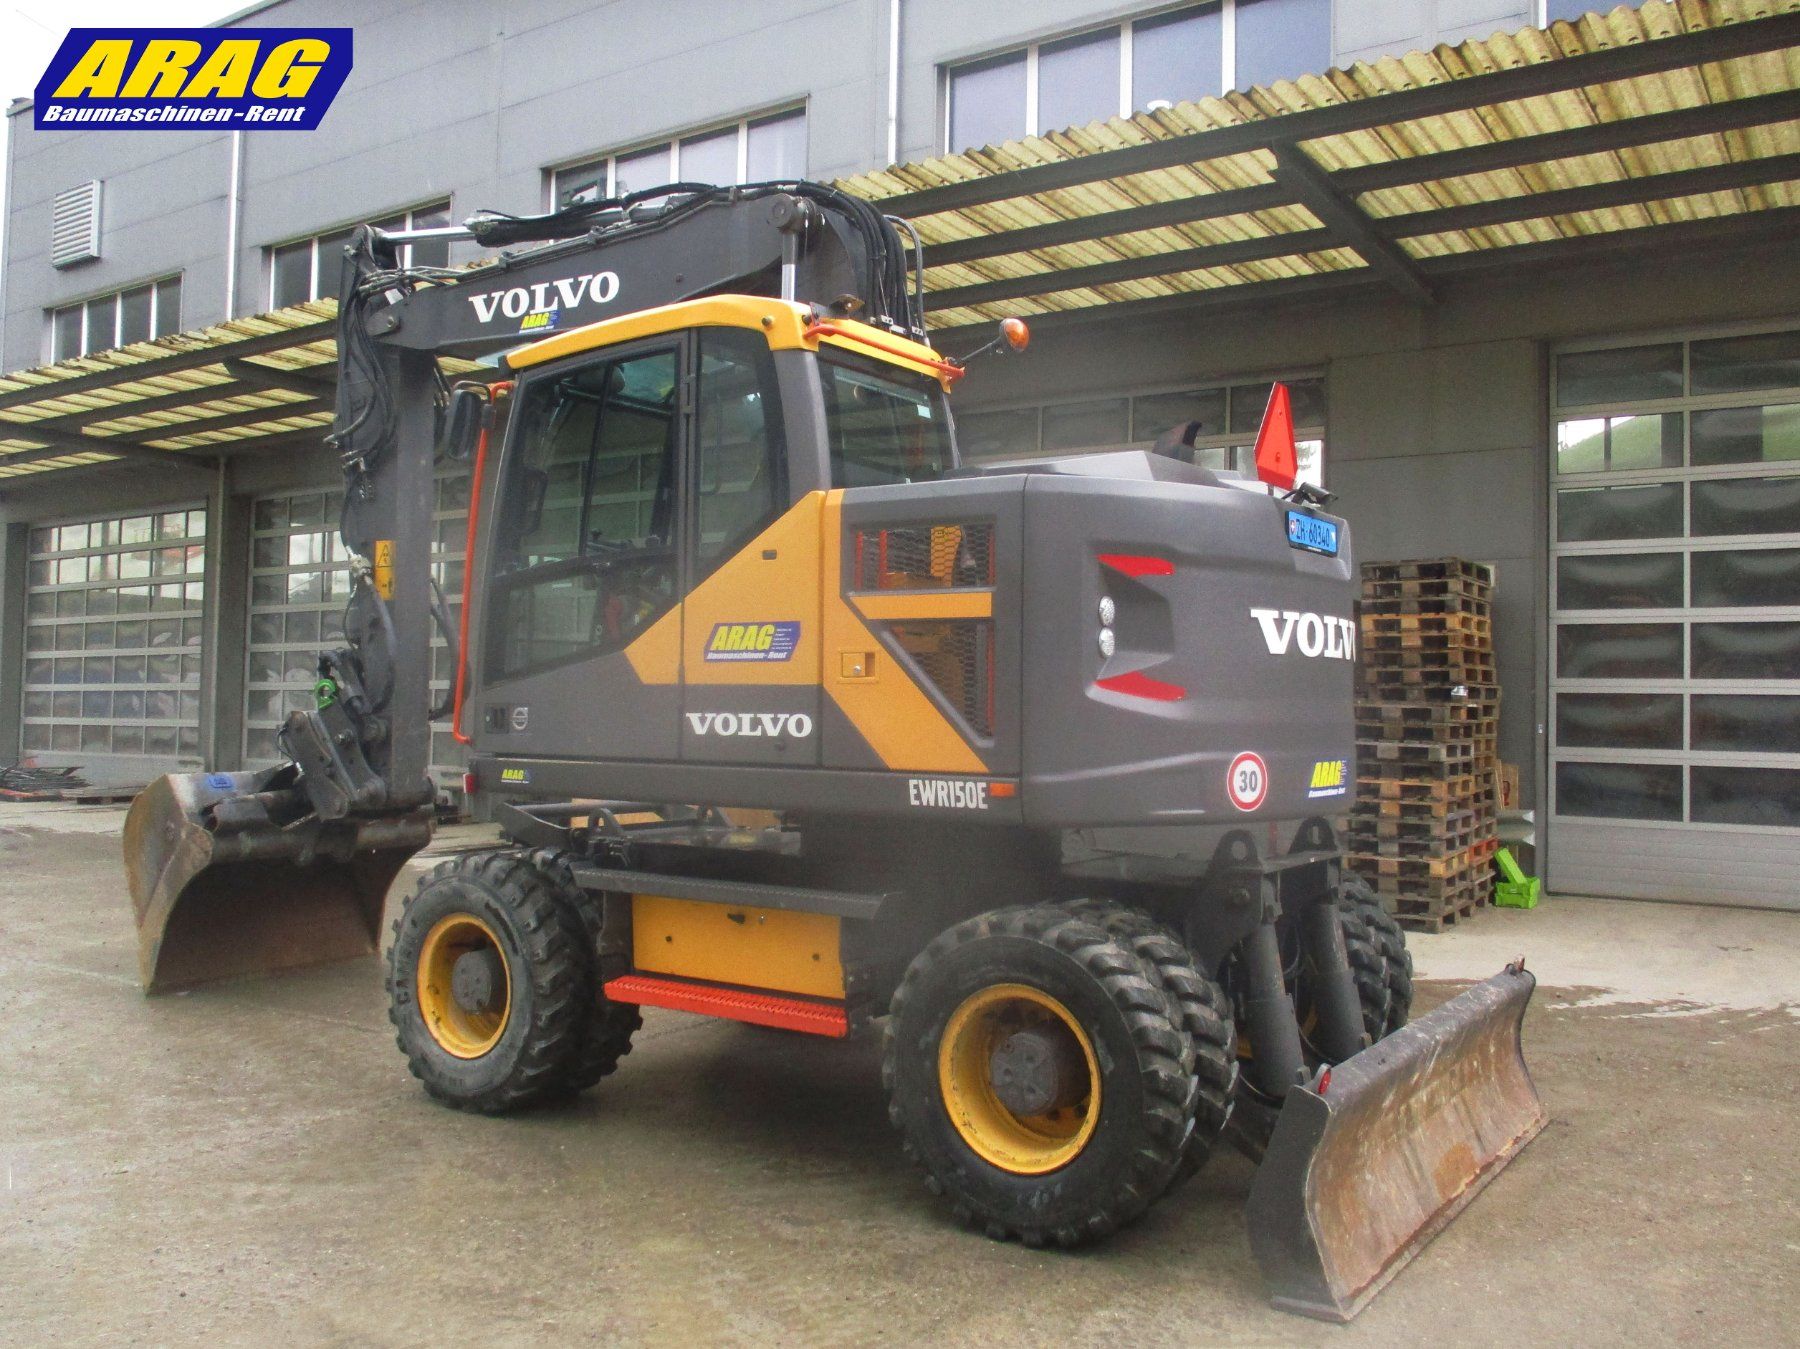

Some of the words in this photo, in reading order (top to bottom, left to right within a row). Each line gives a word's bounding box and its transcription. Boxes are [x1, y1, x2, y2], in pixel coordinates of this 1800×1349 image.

[468, 271, 620, 324] VOLVO
[520, 312, 550, 329] ARAG
[710, 624, 775, 651] ARAG
[1249, 607, 1356, 663] VOLV
[685, 712, 813, 738] VOLVO
[501, 768, 524, 780] ARAG
[1239, 770, 1258, 793] 30
[1310, 759, 1342, 788] ARAG
[908, 779, 988, 809] EWR150E
